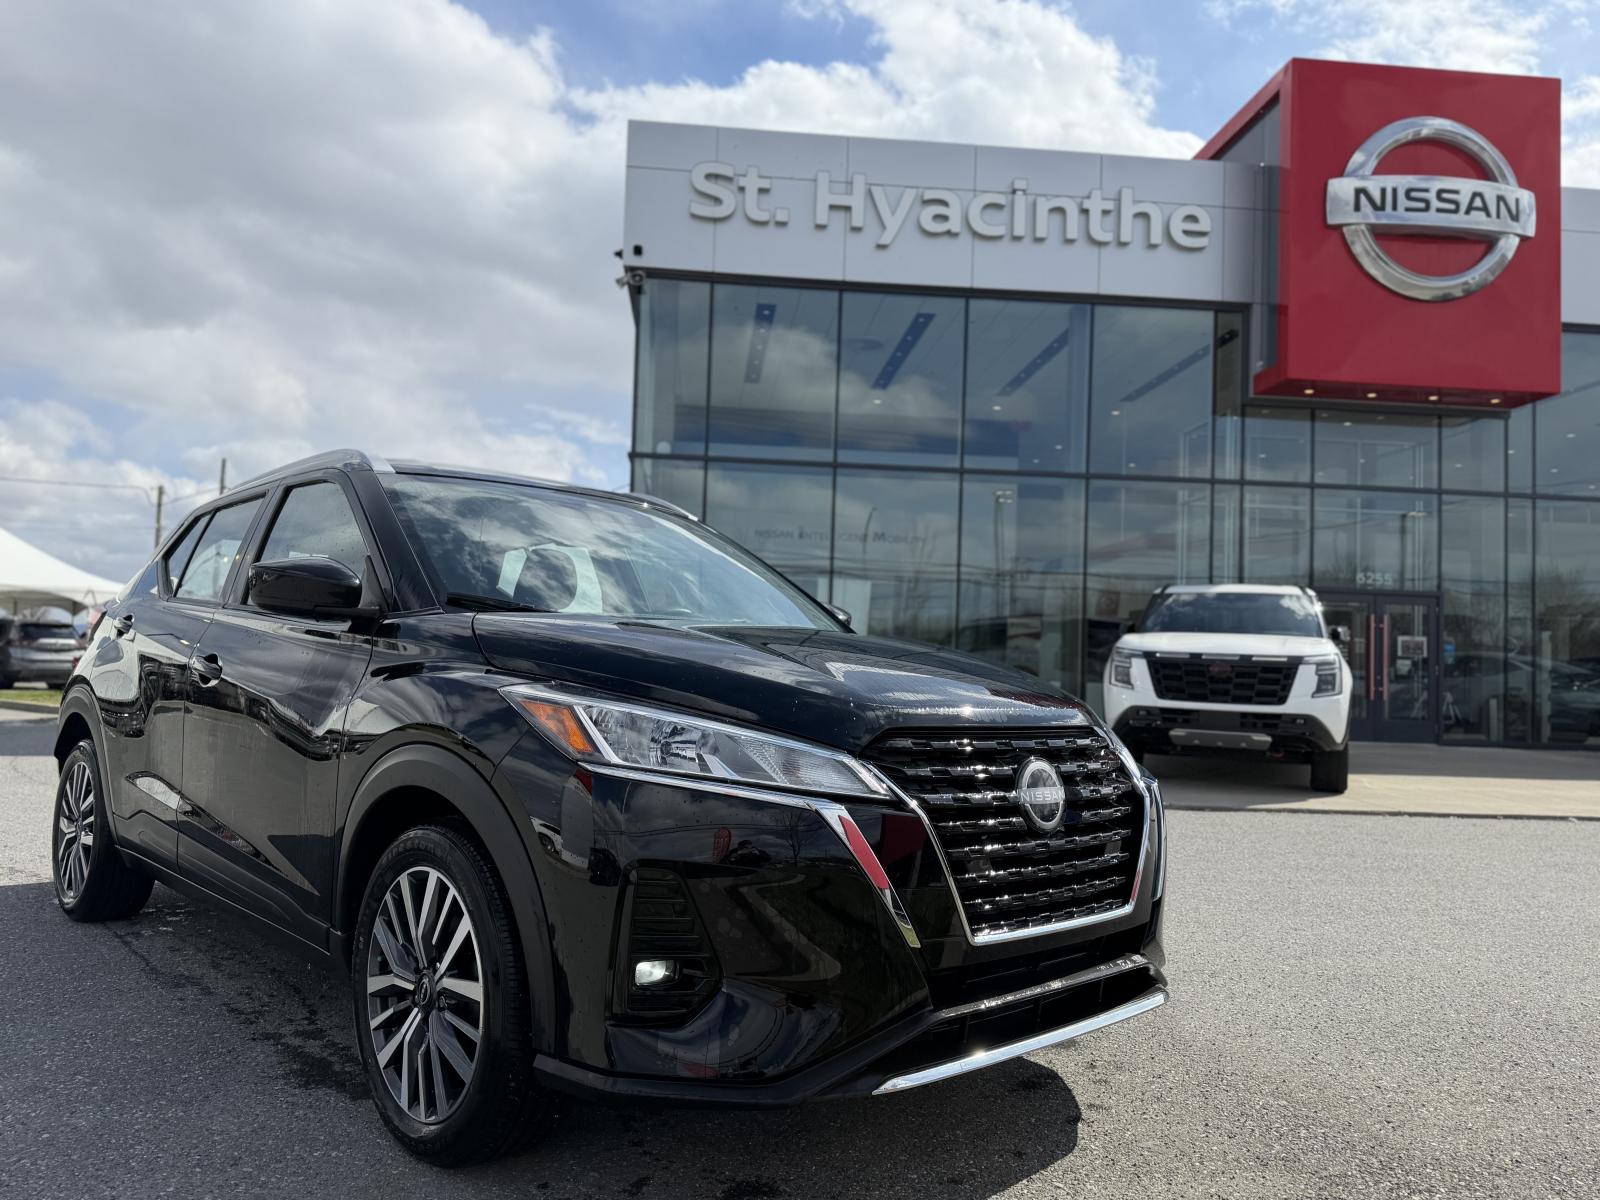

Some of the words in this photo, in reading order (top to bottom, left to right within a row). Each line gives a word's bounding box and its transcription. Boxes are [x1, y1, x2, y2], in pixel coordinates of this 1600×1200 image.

[689, 161, 790, 225] St.
[813, 170, 1213, 250] Hyacinthe
[1353, 186, 1520, 223] NISSAN
[1356, 572, 1393, 585] 6255
[1020, 789, 1065, 801] NISSAN
